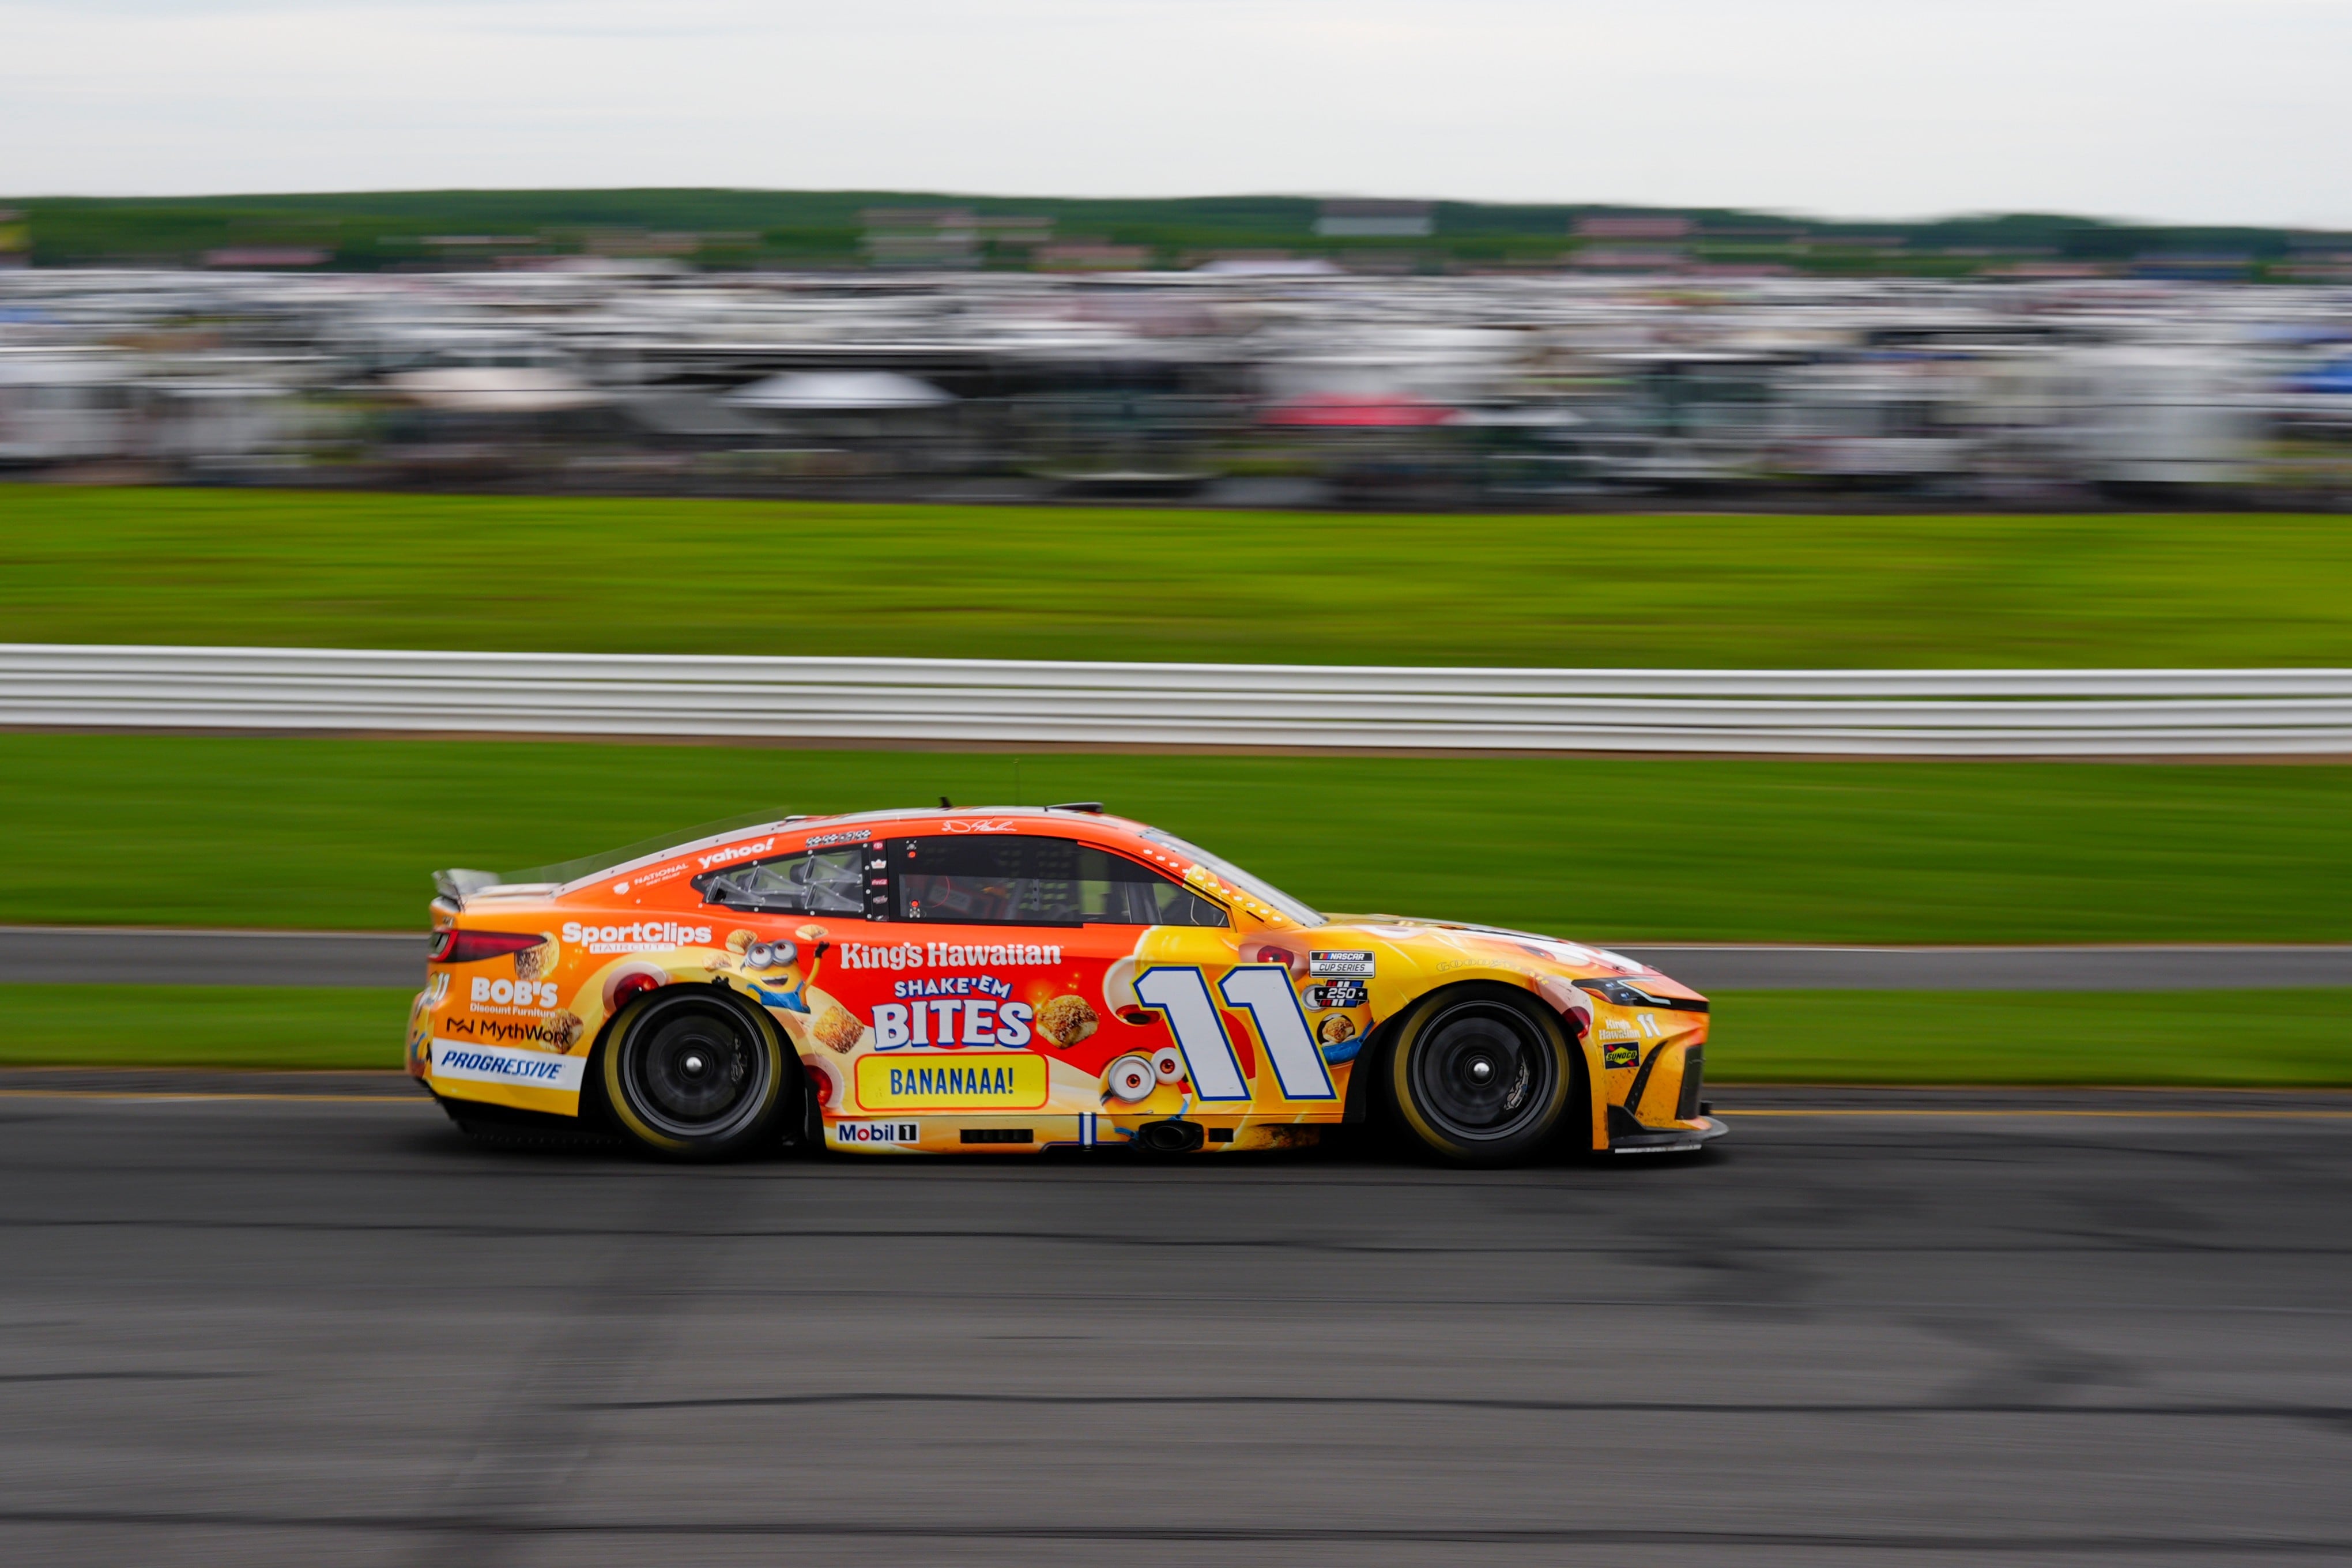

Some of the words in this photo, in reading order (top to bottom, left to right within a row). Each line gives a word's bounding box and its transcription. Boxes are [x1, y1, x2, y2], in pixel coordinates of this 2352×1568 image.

[698, 838, 775, 869] yahoo!
[634, 862, 689, 885] NATIONAL
[562, 922, 712, 947] SportClips
[840, 942, 923, 970] King's
[926, 943, 1062, 967] Hawaiian
[1337, 963, 1366, 971] SERIES
[470, 977, 558, 1008] BOB'S
[894, 974, 1012, 1000] SHAKE'EM
[1326, 987, 1356, 998] 250
[470, 1002, 511, 1015] Discount
[512, 1005, 556, 1017] Furniture
[872, 999, 1034, 1050] BITES
[1131, 965, 1338, 1102] 11
[1637, 1013, 1661, 1038] 11
[441, 1050, 561, 1079] PROGRESSIVE
[1607, 1051, 1637, 1060] SUNOCO
[890, 1068, 1013, 1095] BANANAAA!
[839, 1124, 894, 1141] Mobil
[901, 1125, 914, 1140] 1
